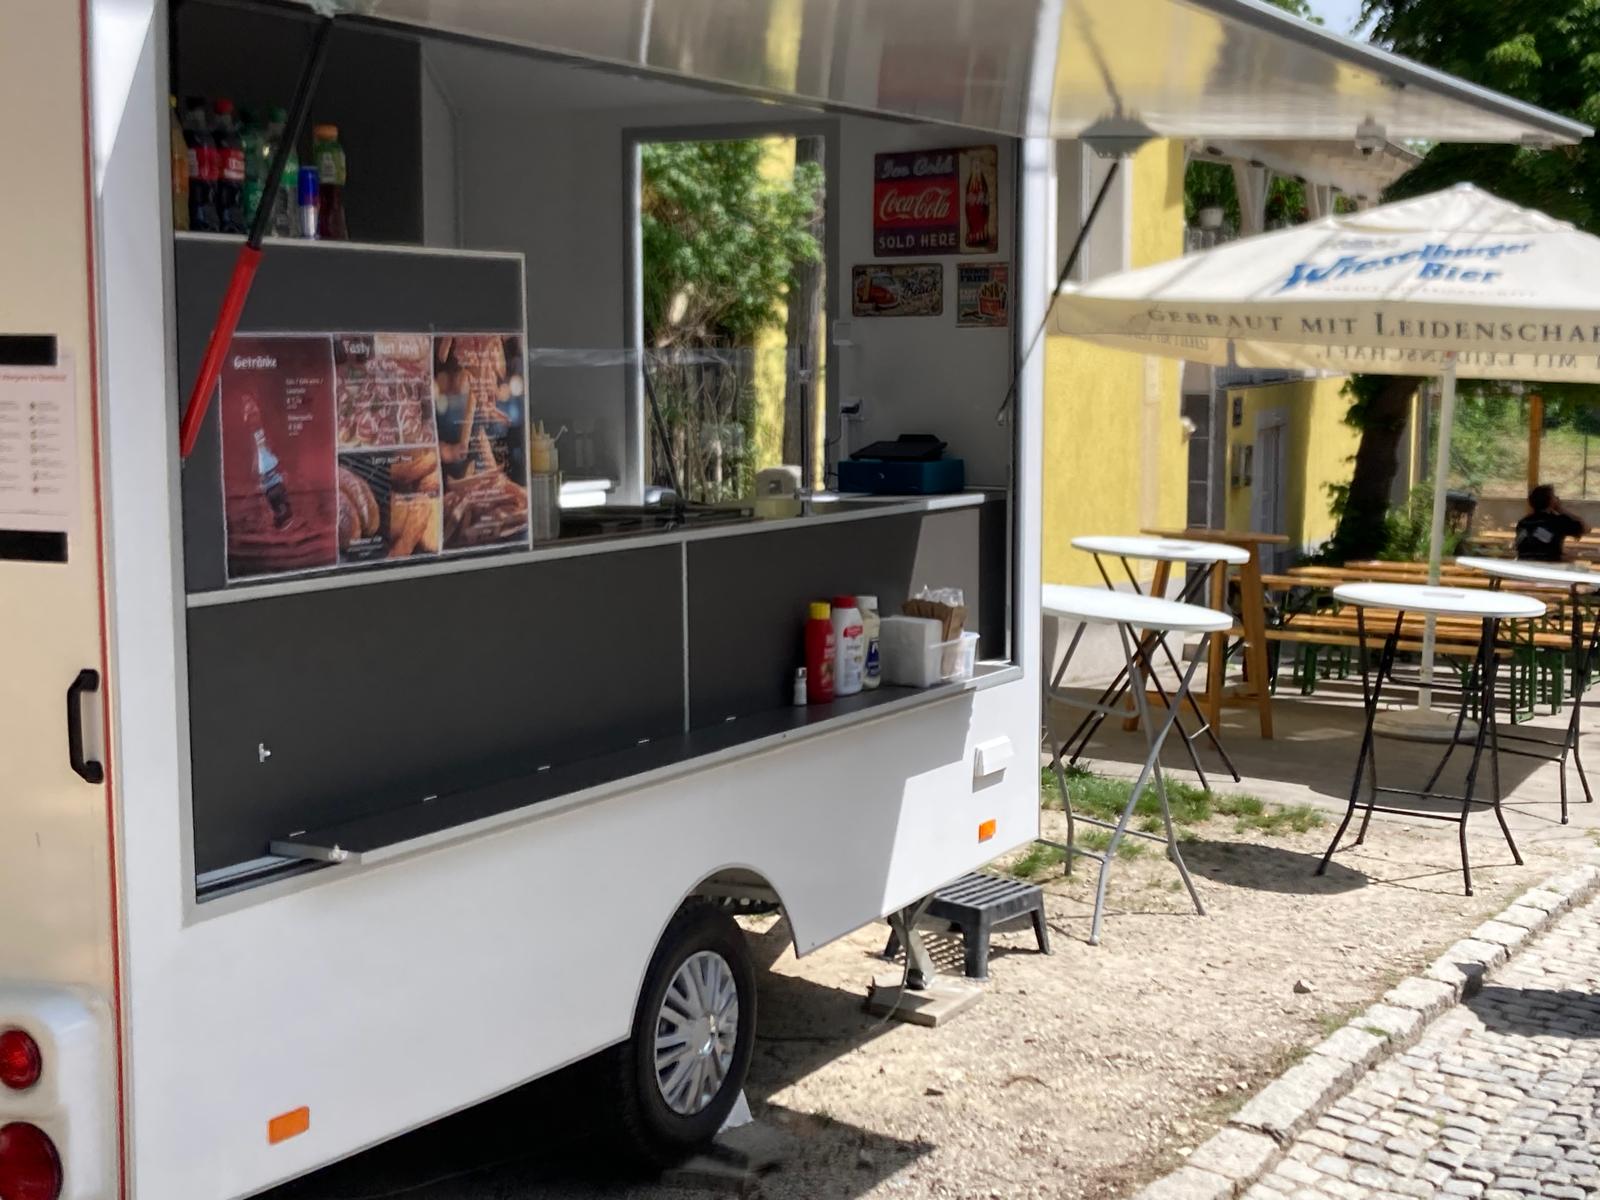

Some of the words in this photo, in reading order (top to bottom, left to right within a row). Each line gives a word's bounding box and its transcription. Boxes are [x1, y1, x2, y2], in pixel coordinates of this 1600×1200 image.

[913, 155, 953, 176] Cold
[879, 187, 952, 221] Coca-Cola
[879, 234, 915, 249] SOLD
[921, 231, 957, 248] HERE
[1418, 262, 1503, 283] Bier
[1147, 308, 1283, 332] GEBRAUT
[1301, 318, 1358, 335] MIT
[342, 340, 370, 358] Tasty
